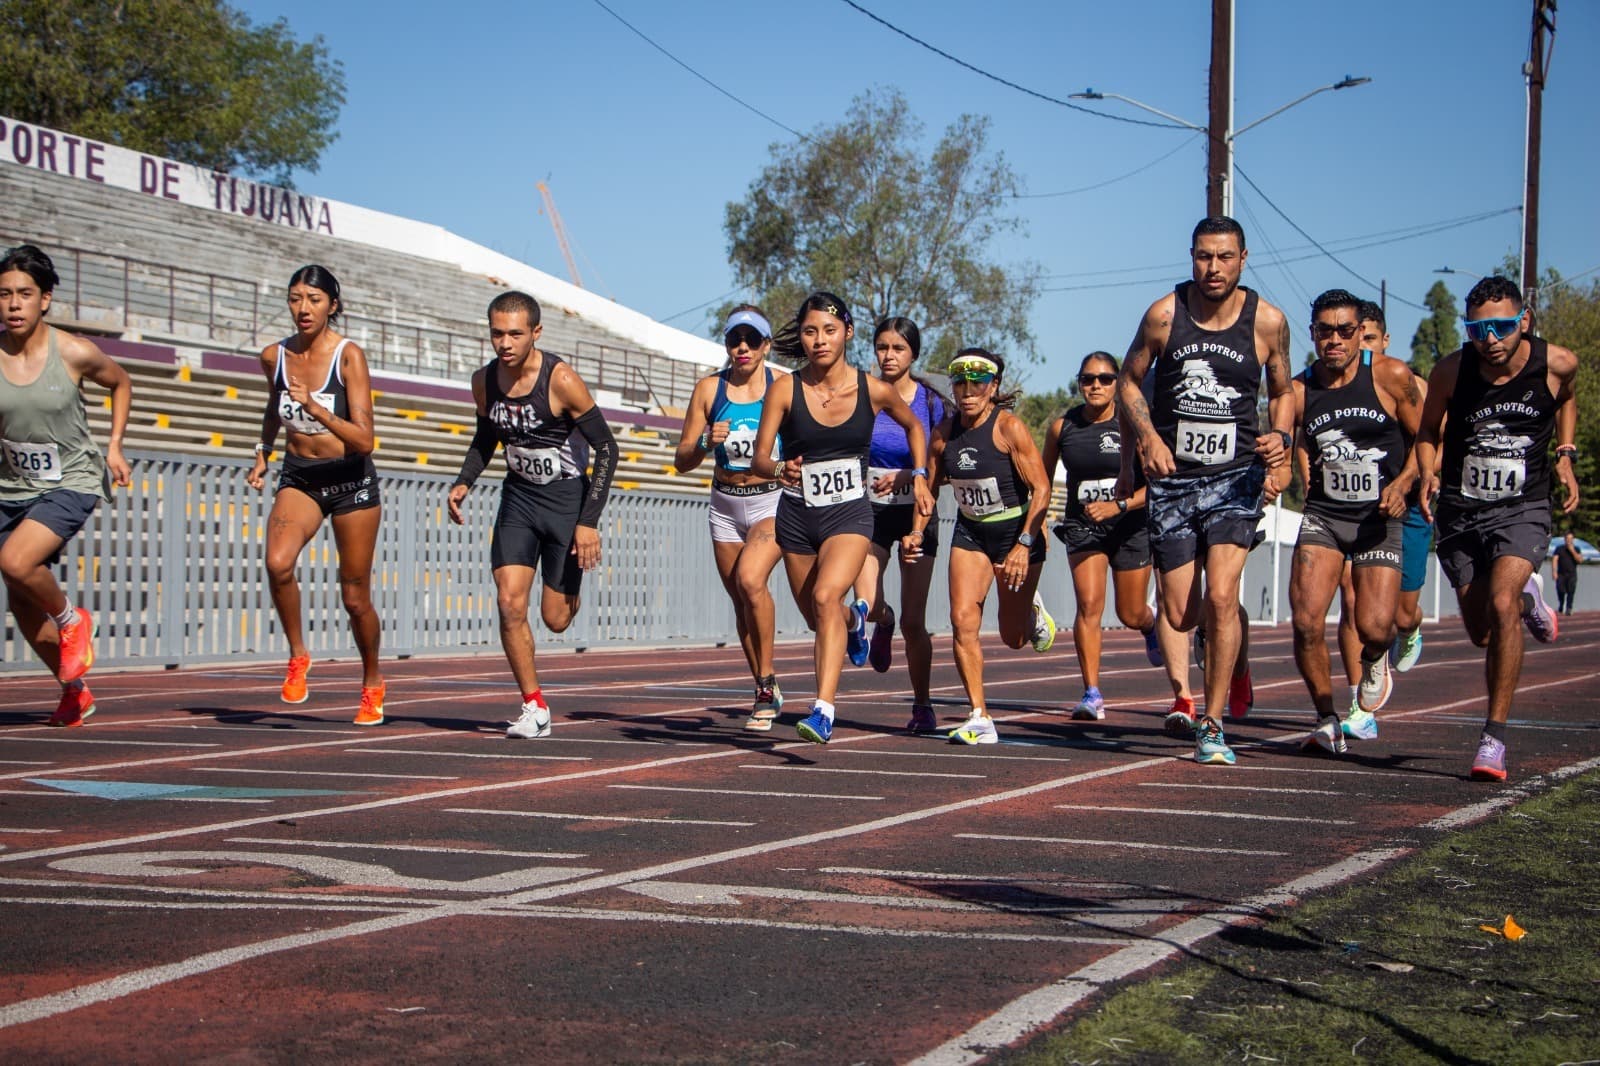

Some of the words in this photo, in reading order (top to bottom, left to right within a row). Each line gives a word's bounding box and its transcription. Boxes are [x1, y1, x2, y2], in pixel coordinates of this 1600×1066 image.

[141, 156, 179, 200] DE
[211, 173, 333, 235] TIJUANA
[1172, 343, 1199, 360] CLUB
[1202, 342, 1244, 363] POTROS
[1179, 404, 1232, 416] INTERNACIONAL
[1495, 402, 1540, 418] POTROS
[1306, 413, 1331, 435] CLUB
[1334, 407, 1386, 423] POTROS
[1184, 431, 1229, 455] 3264
[10, 449, 53, 470] 3263
[514, 455, 554, 476] 3268
[719, 484, 763, 495] GRADUAL
[810, 468, 855, 496] 3261
[1330, 472, 1372, 492] 3106
[1469, 467, 1517, 491] 3114
[959, 487, 996, 506] 3301
